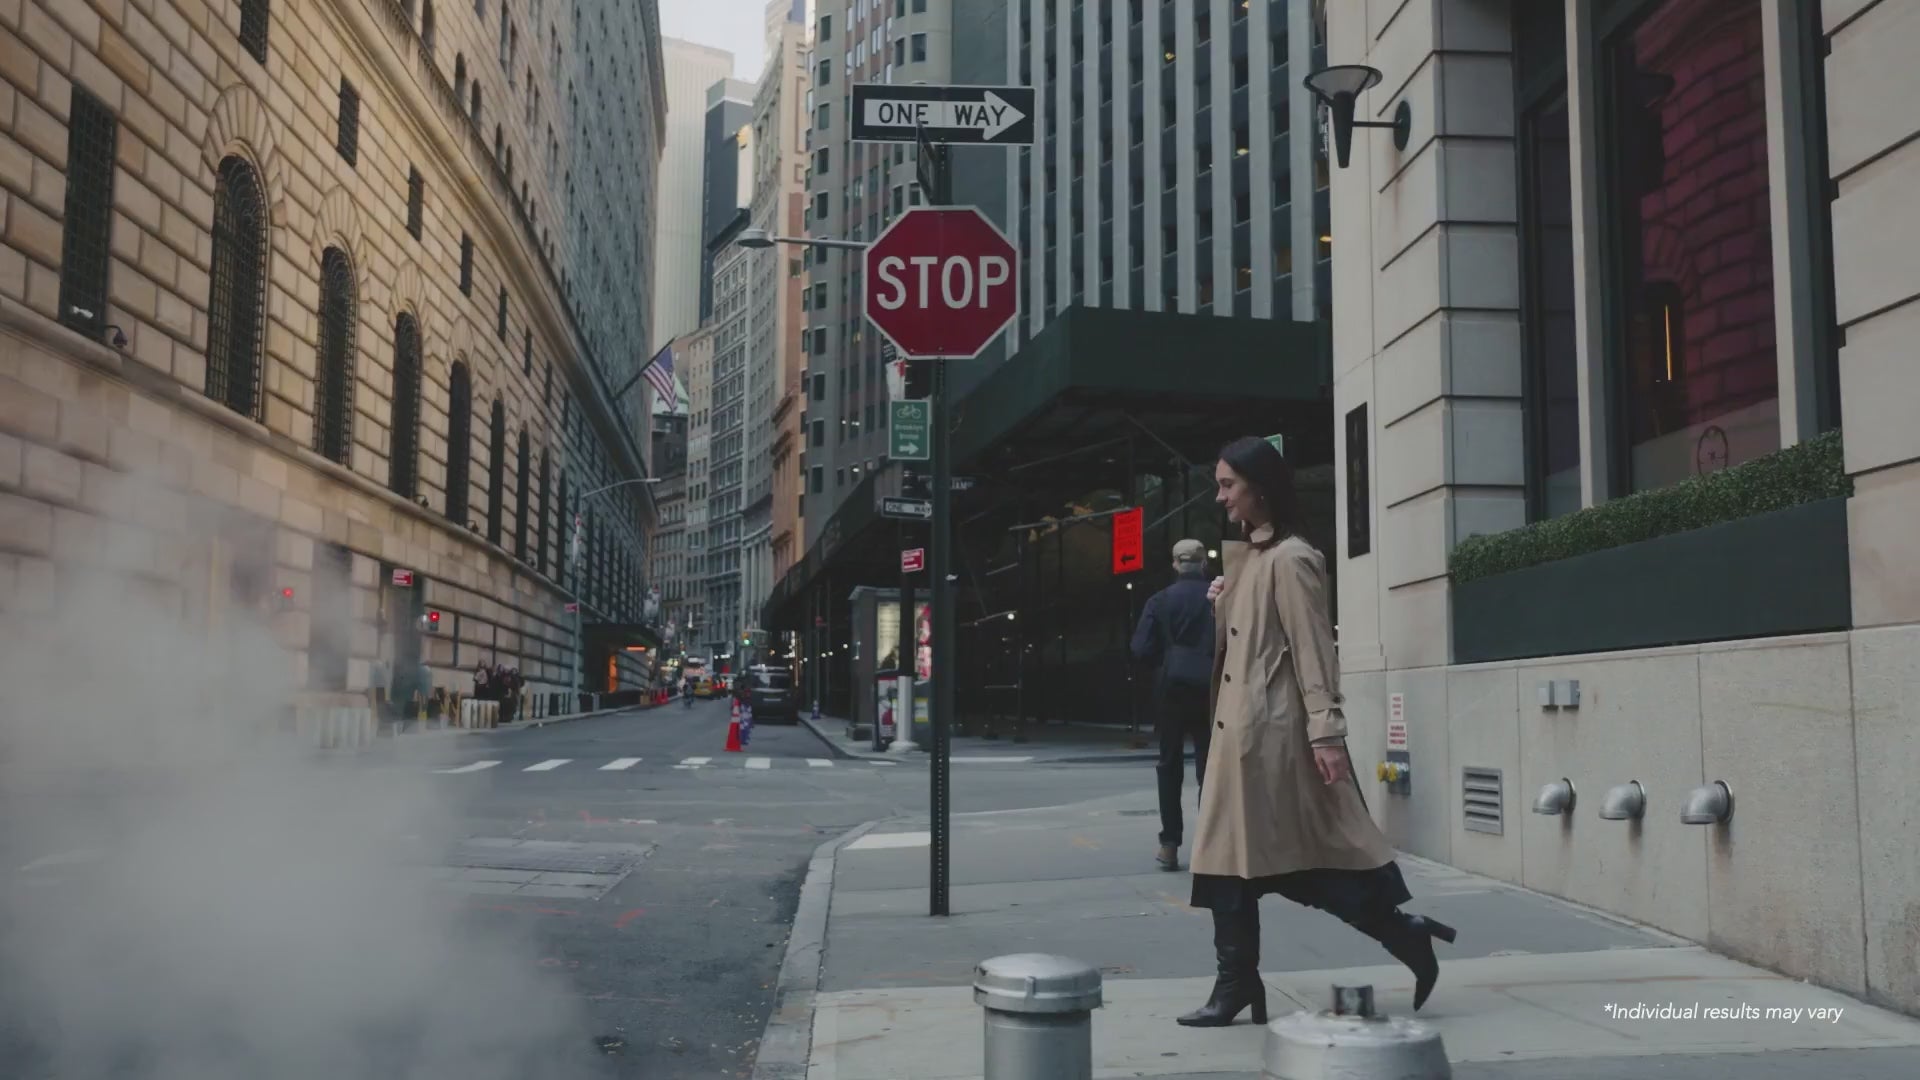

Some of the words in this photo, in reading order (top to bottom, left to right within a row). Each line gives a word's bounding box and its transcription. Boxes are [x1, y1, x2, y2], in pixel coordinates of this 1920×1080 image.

[878, 103, 929, 124] ONE
[954, 104, 1008, 126] WAY
[876, 256, 1010, 310] STOP
